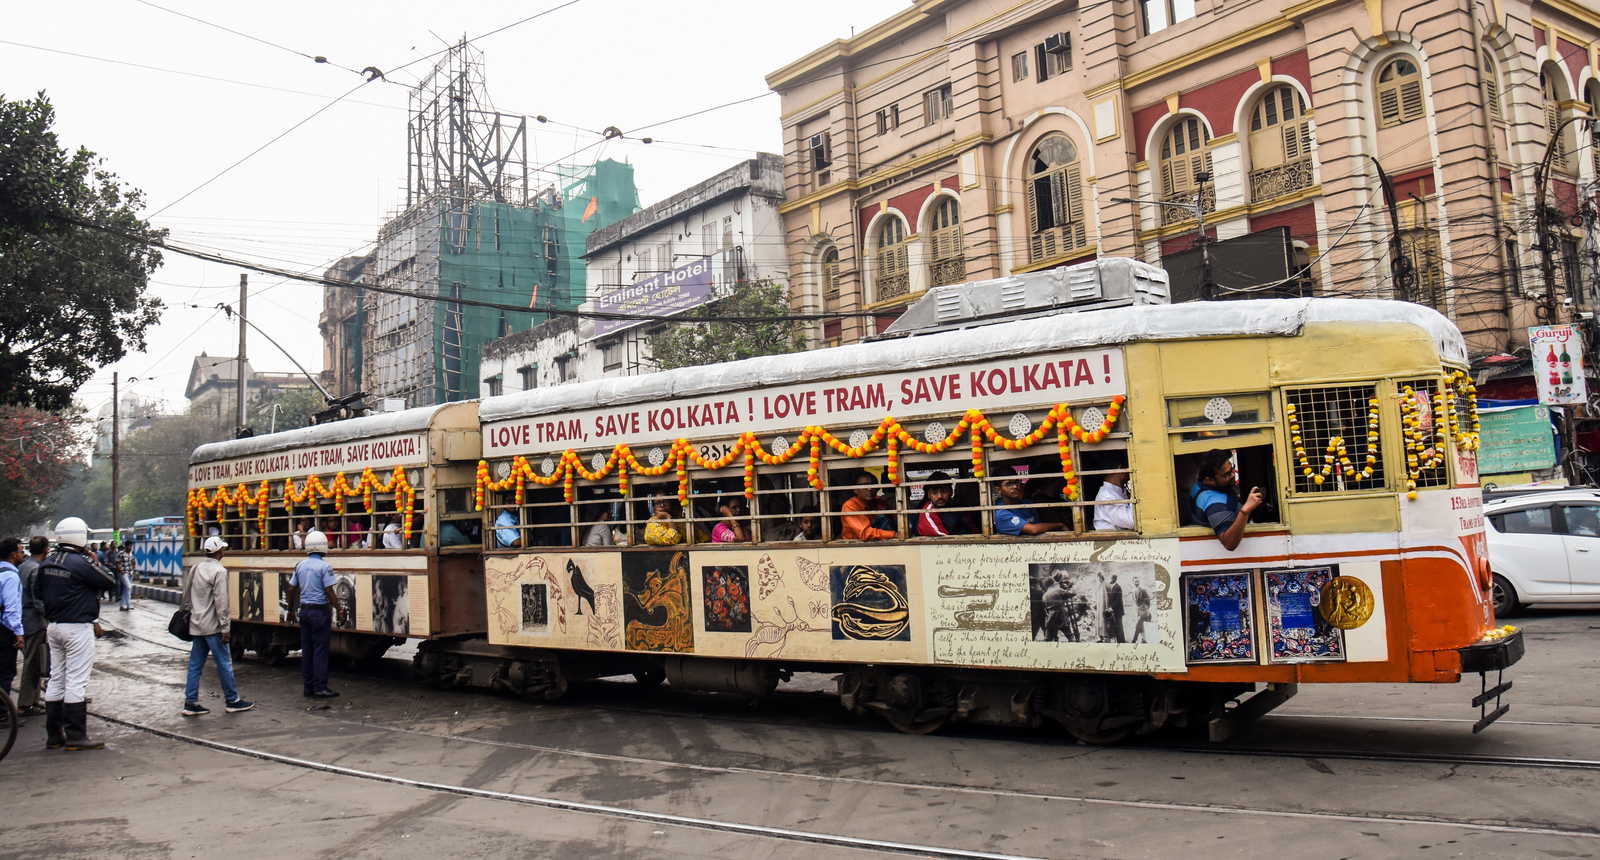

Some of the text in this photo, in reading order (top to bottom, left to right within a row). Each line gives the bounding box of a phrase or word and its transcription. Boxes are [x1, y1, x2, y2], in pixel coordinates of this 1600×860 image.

[600, 277, 659, 308] Eminent
[664, 259, 707, 285] Hotel
[1536, 326, 1573, 342] Guruji
[490, 425, 530, 448] LOVE
[536, 419, 588, 442] TRAM,
[595, 412, 640, 437] SAVE
[648, 400, 740, 432] KOLKATA
[763, 391, 817, 420] LOVE
[823, 383, 893, 412] TRAM,
[901, 373, 962, 405] SAVE
[970, 358, 1095, 398] KOLKATA
[195, 467, 211, 483] LOVE
[213, 464, 233, 480] TRAM,
[235, 461, 252, 478] SAVE
[255, 455, 290, 475] KOLKATA
[298, 451, 318, 468] LOVE
[320, 448, 344, 467] TRAM,
[347, 444, 369, 462] SAVE
[372, 438, 415, 461] KOLKATA
